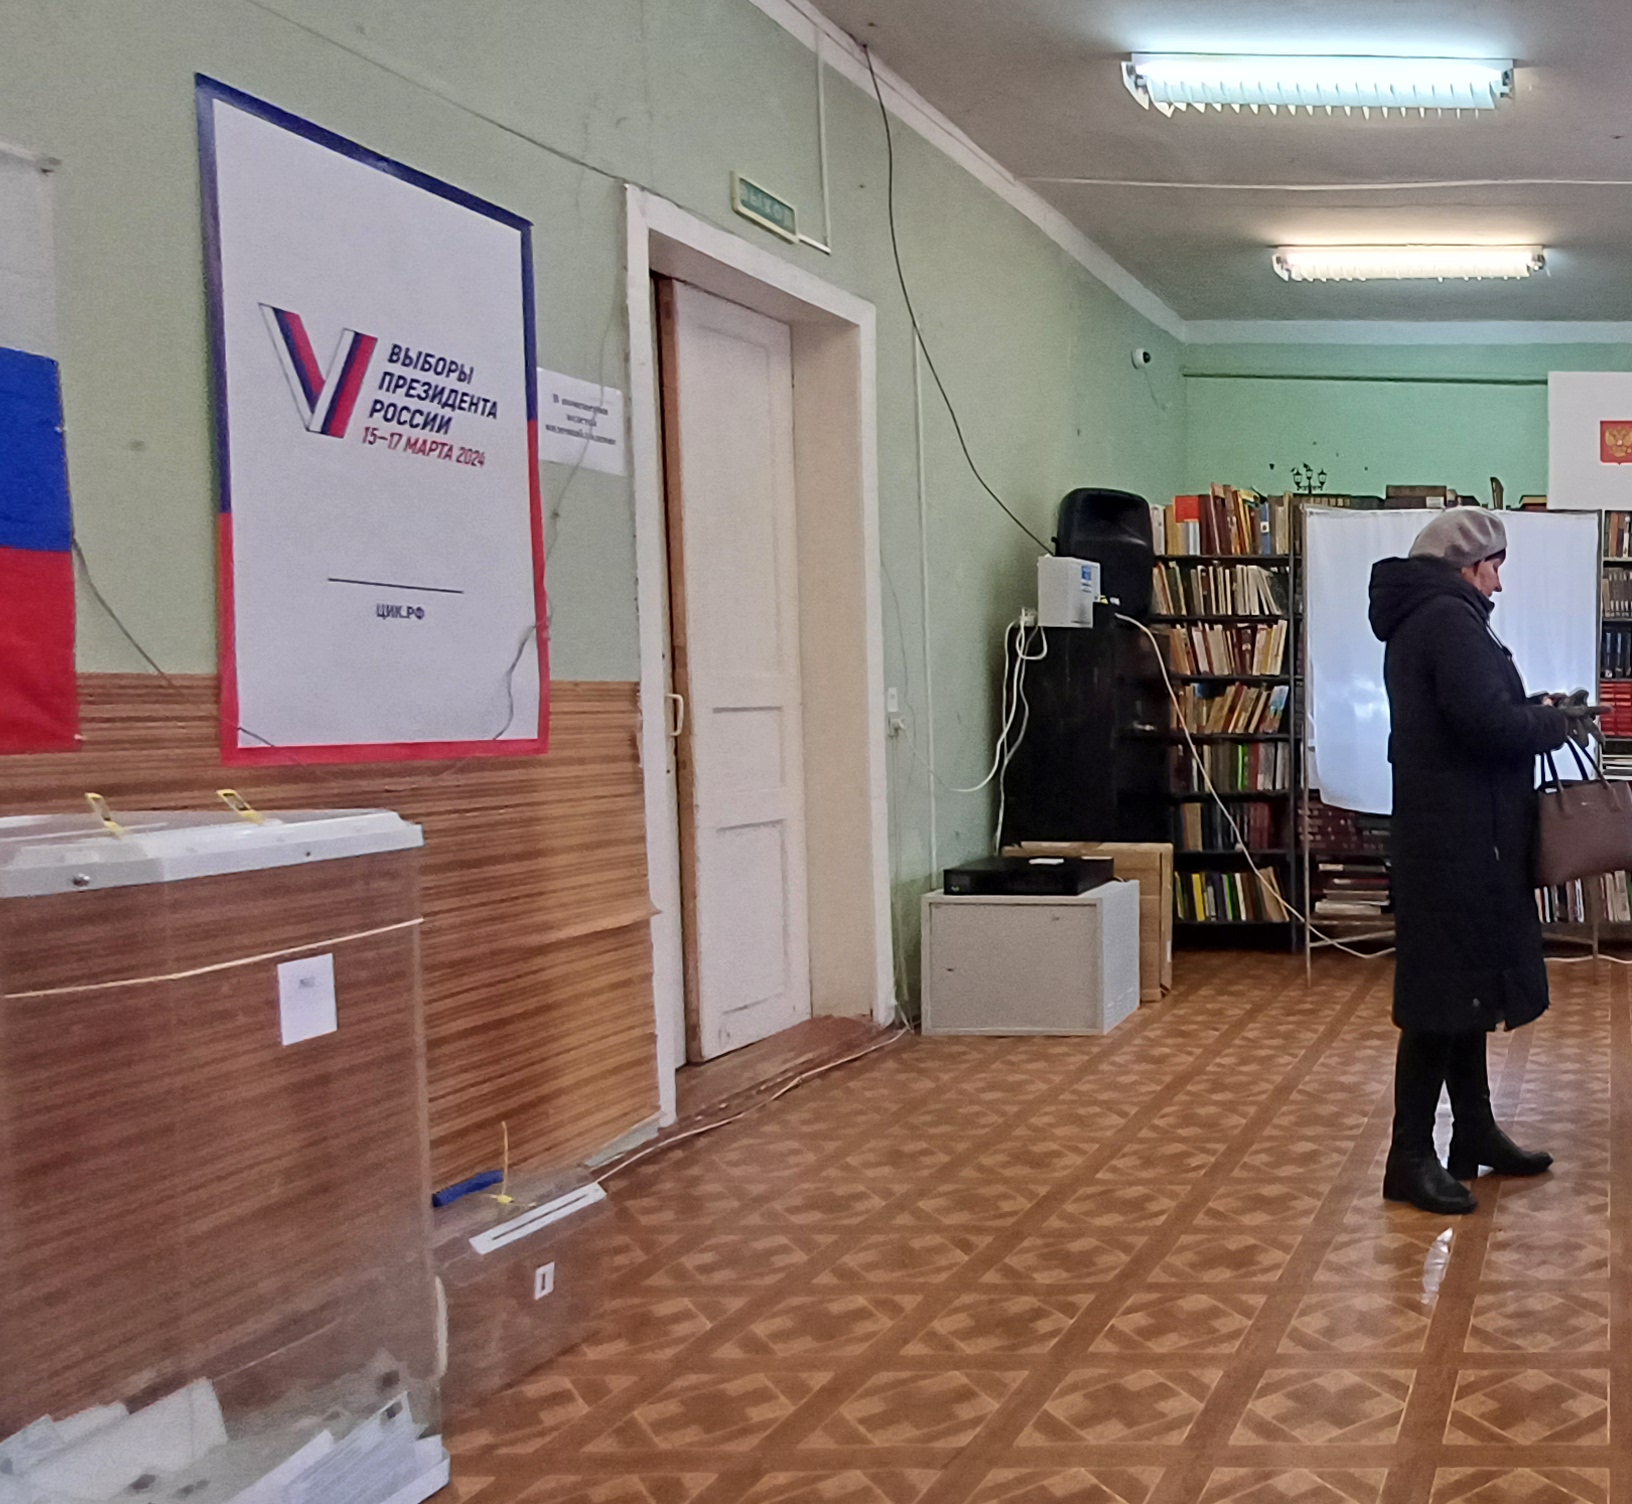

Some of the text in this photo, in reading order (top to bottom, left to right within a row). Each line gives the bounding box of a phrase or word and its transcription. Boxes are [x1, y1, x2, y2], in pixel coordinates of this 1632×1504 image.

[387, 343, 474, 385] ВЫБОРЫ
[378, 371, 498, 419] ПРЕЗИДЕНТА
[368, 398, 453, 435] РОССИИ
[402, 436, 454, 462] МАРТА
[455, 446, 486, 467] 2024
